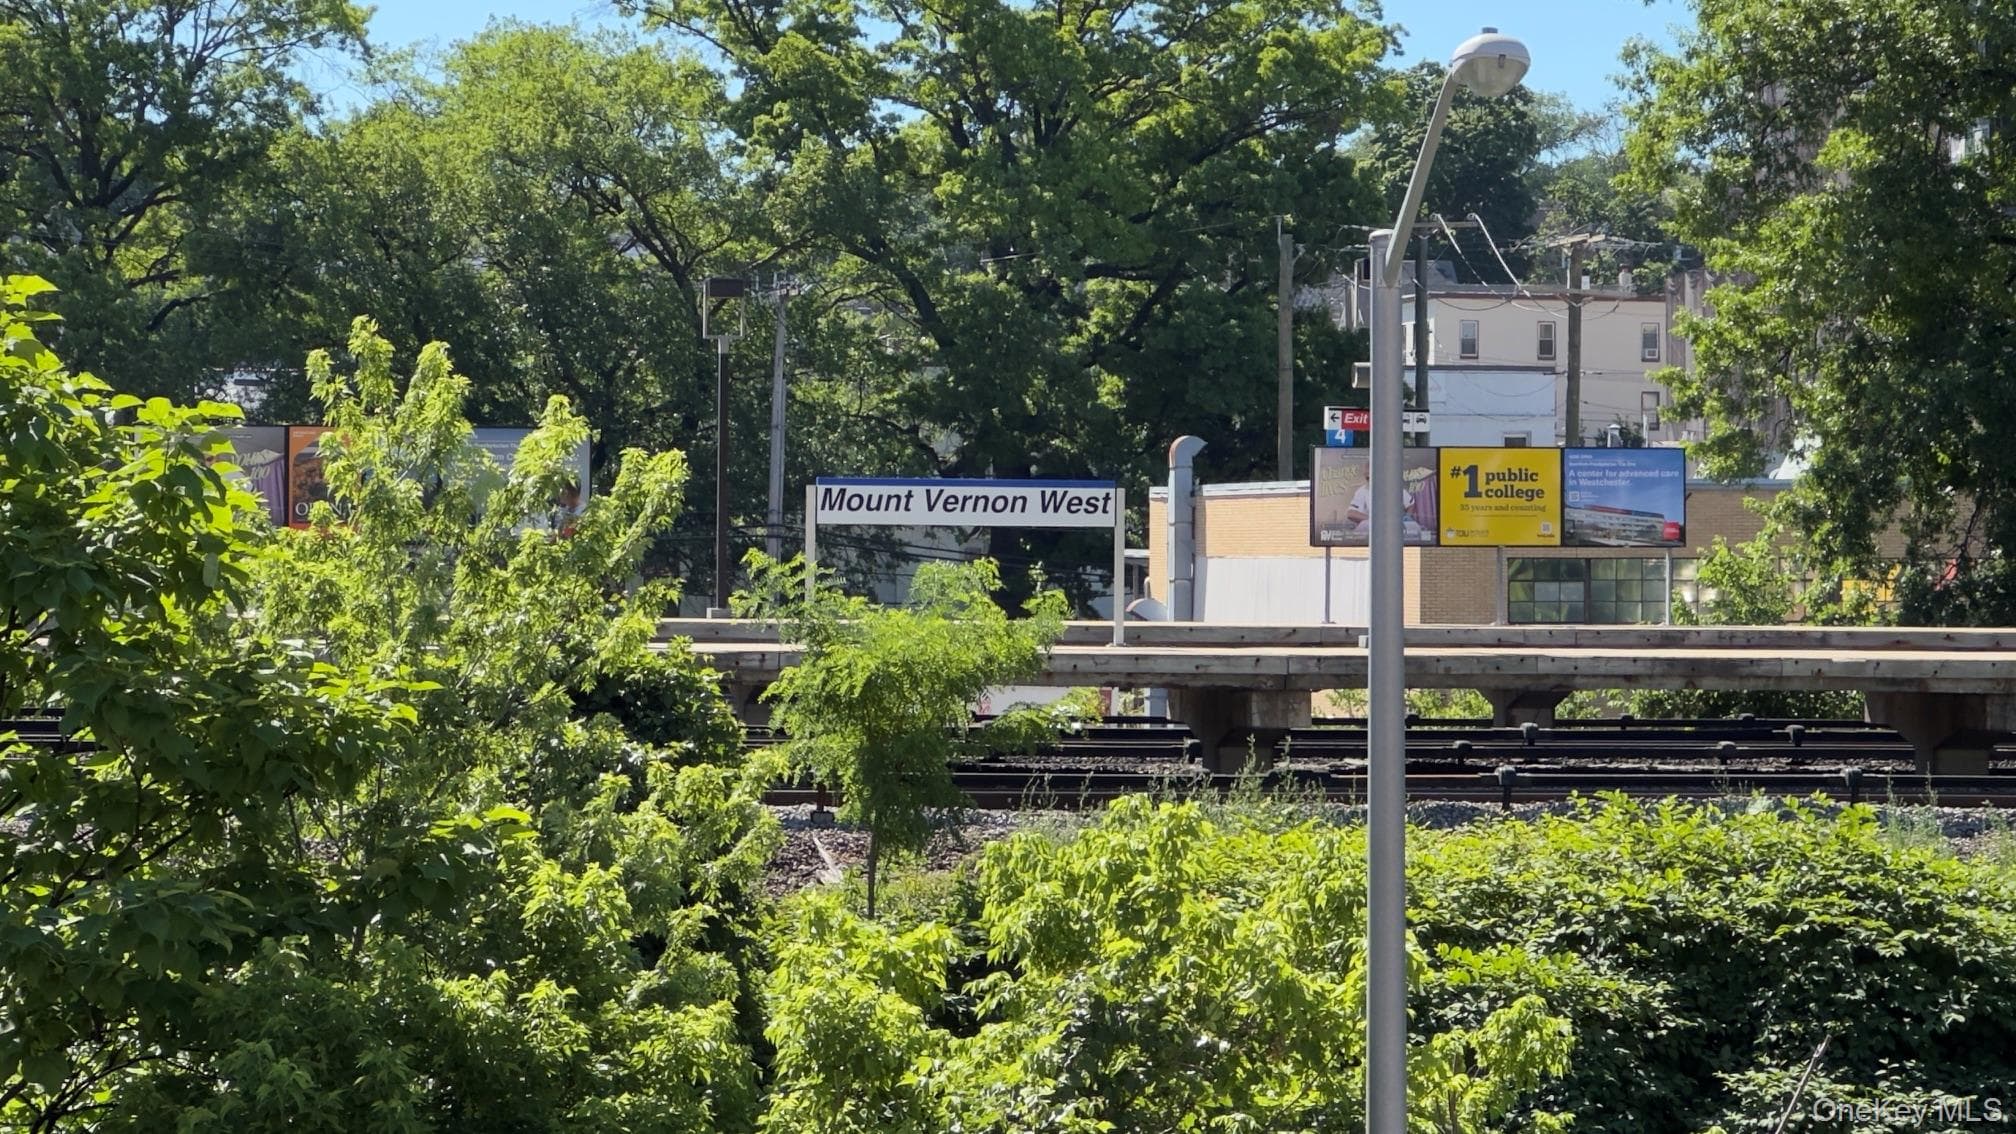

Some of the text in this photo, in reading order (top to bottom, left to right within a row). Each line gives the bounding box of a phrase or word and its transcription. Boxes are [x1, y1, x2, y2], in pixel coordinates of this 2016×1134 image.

[1344, 413, 1368, 424] Exit
[1334, 429, 1346, 444] 4
[1485, 467, 1539, 485] public
[1569, 470, 1680, 478] A center for advanced care
[1568, 479, 1577, 487] in
[1485, 484, 1545, 502] college
[820, 487, 1111, 514] Mount Vernon West
[1471, 504, 1493, 512] years
[1494, 503, 1509, 512] and
[1510, 503, 1547, 513] counting
